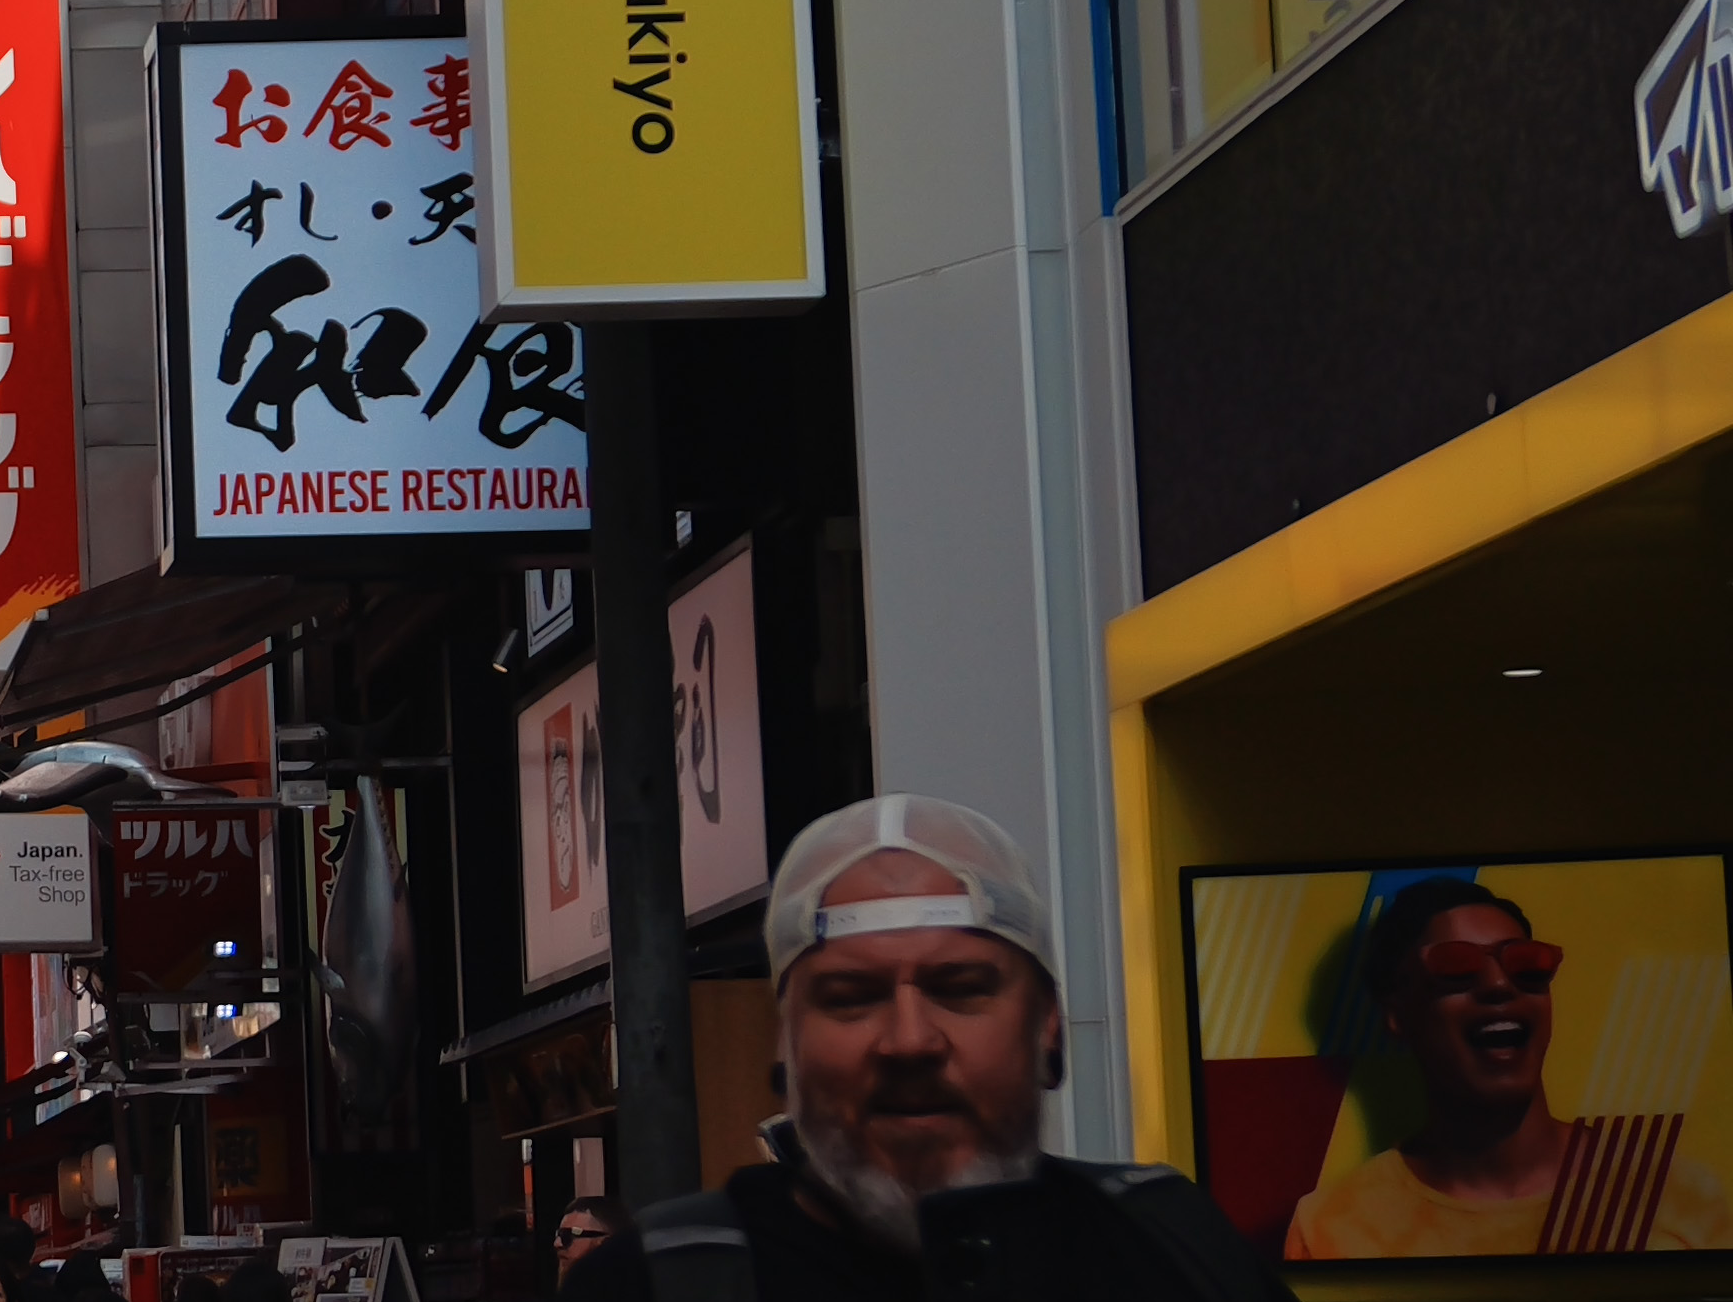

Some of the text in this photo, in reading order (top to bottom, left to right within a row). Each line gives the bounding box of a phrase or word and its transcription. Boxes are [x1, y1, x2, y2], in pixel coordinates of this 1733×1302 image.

[217, 254, 587, 453] 和食
[213, 466, 591, 516] JAPANESE RESTAURA
[17, 841, 84, 860] Japan.
[119, 819, 253, 860] ツルハ
[9, 865, 85, 883] Tax-free
[123, 868, 228, 899] ドラッグ
[38, 884, 86, 905] Shop
